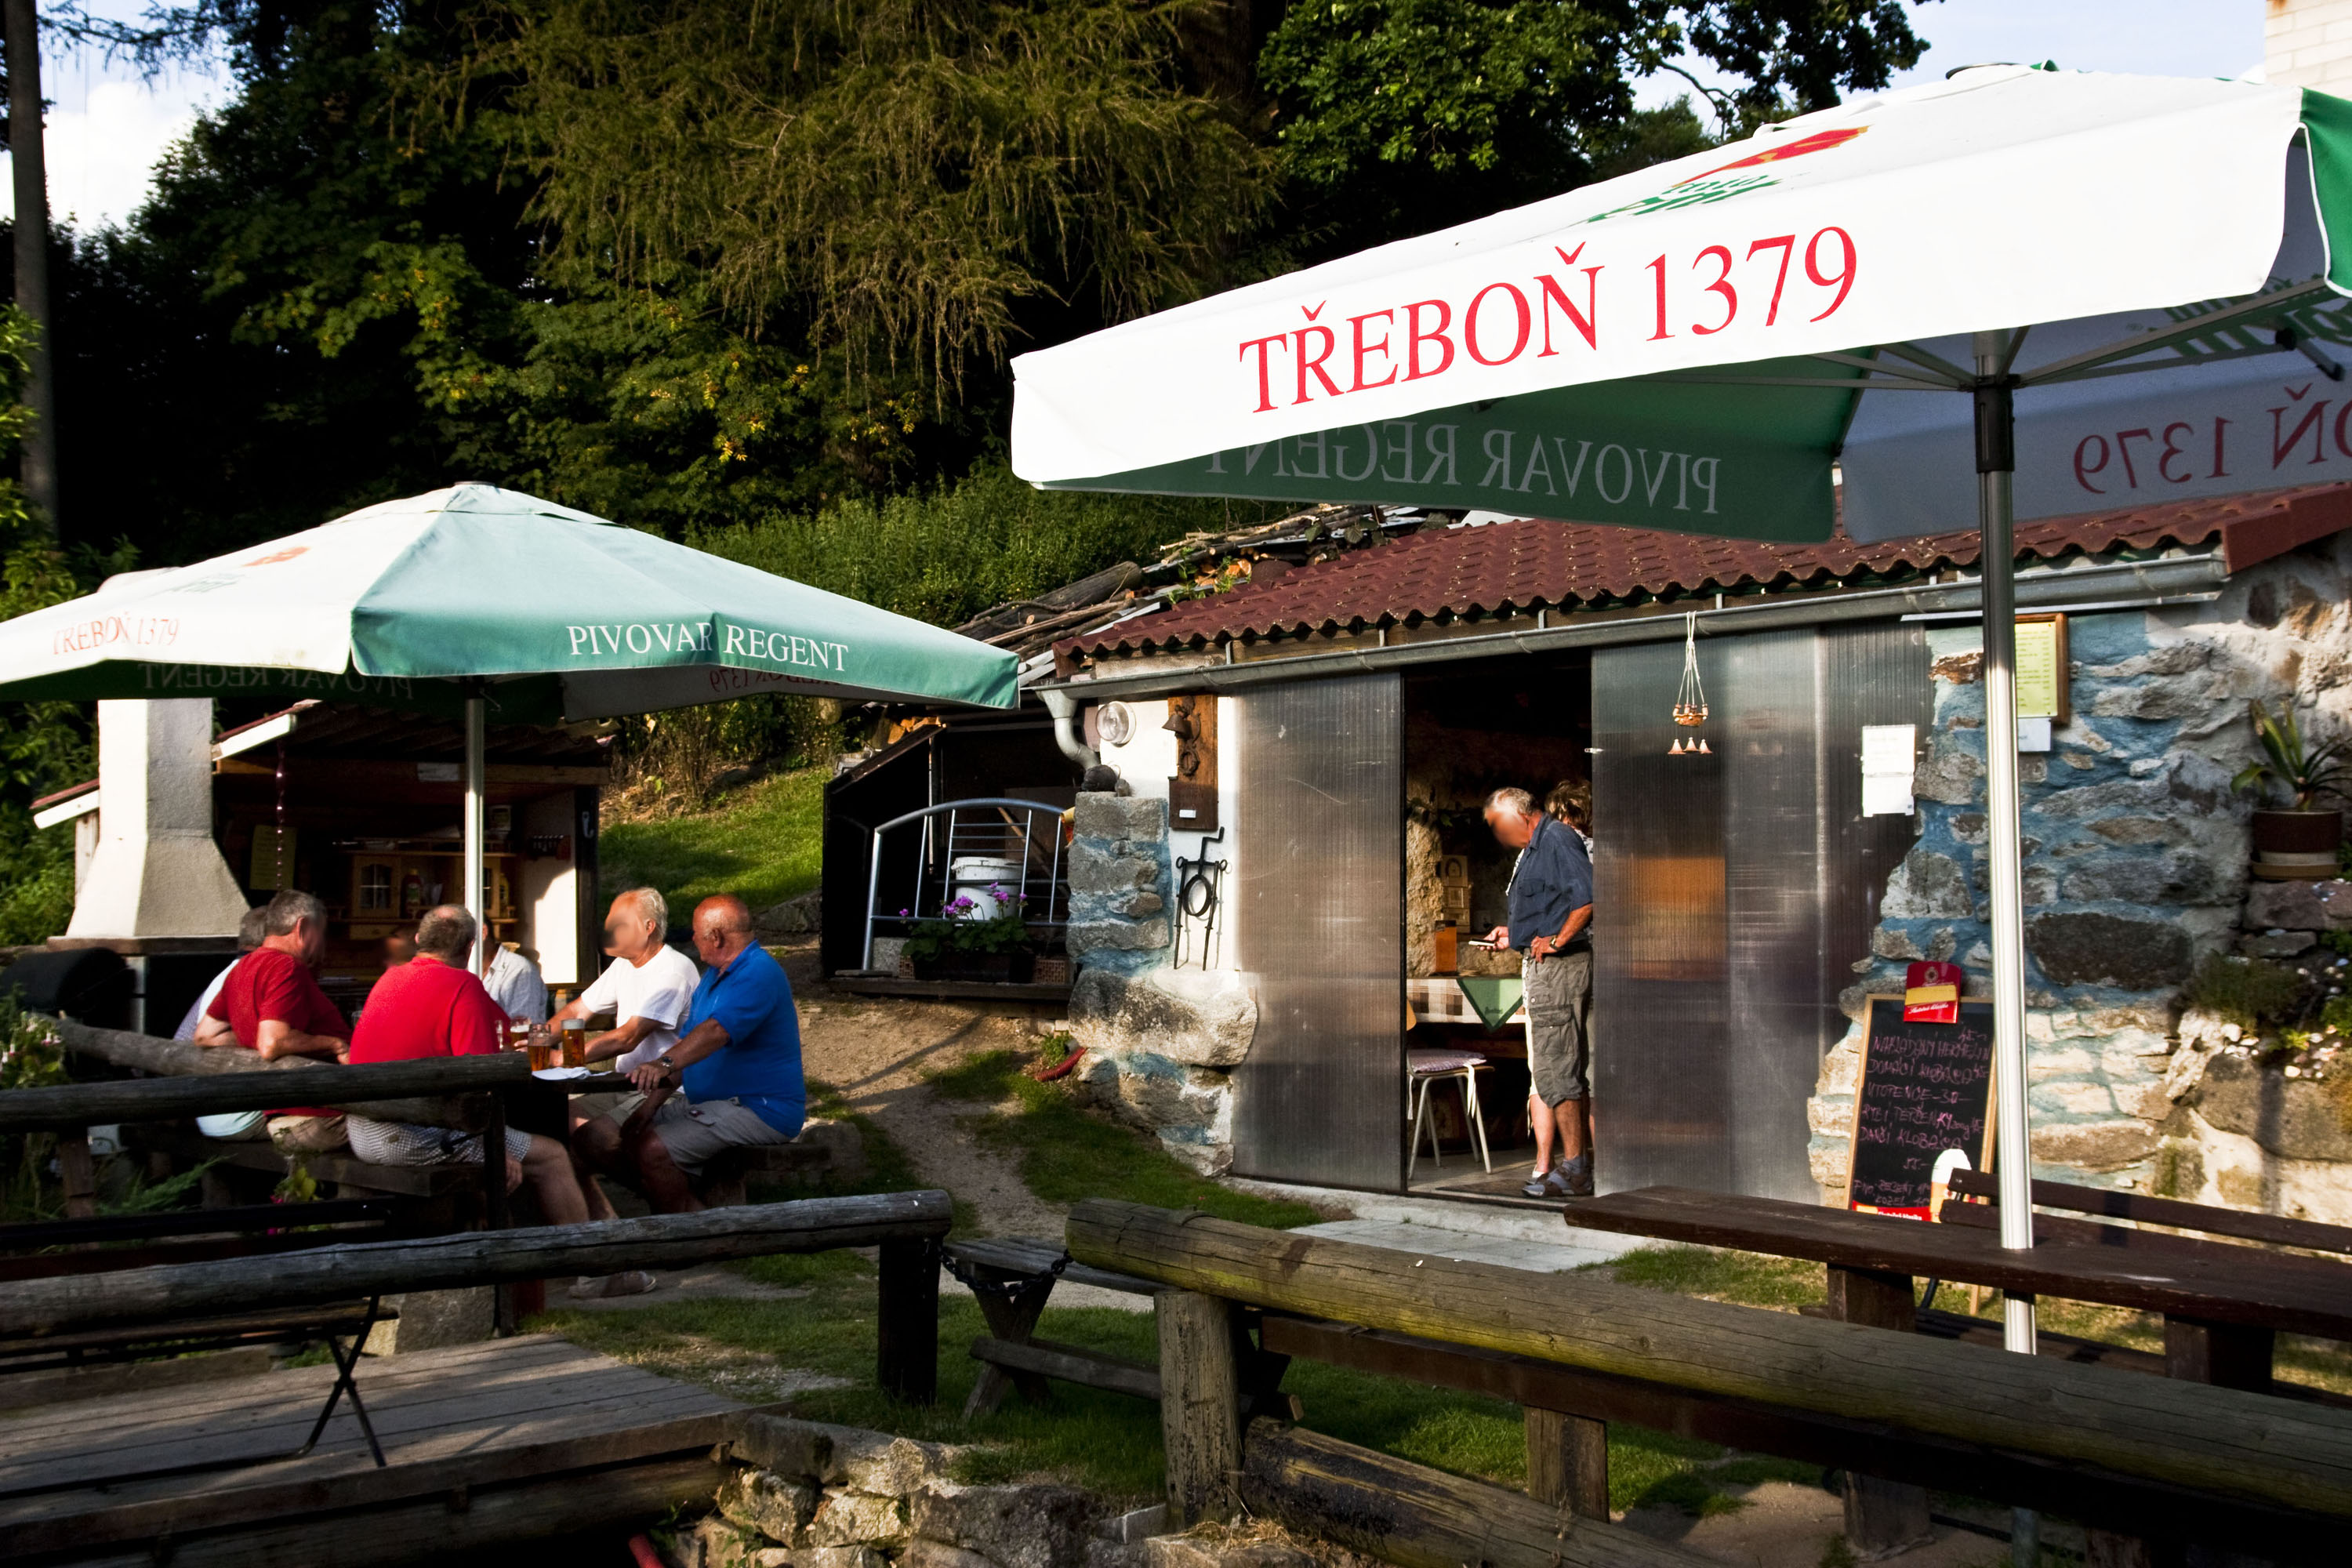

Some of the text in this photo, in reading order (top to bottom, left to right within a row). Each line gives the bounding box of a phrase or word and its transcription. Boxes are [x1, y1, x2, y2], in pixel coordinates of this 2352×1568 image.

[1240, 225, 1857, 412] TŘEBOŇ 1379
[567, 622, 849, 672] PIVOVAR REGENT
